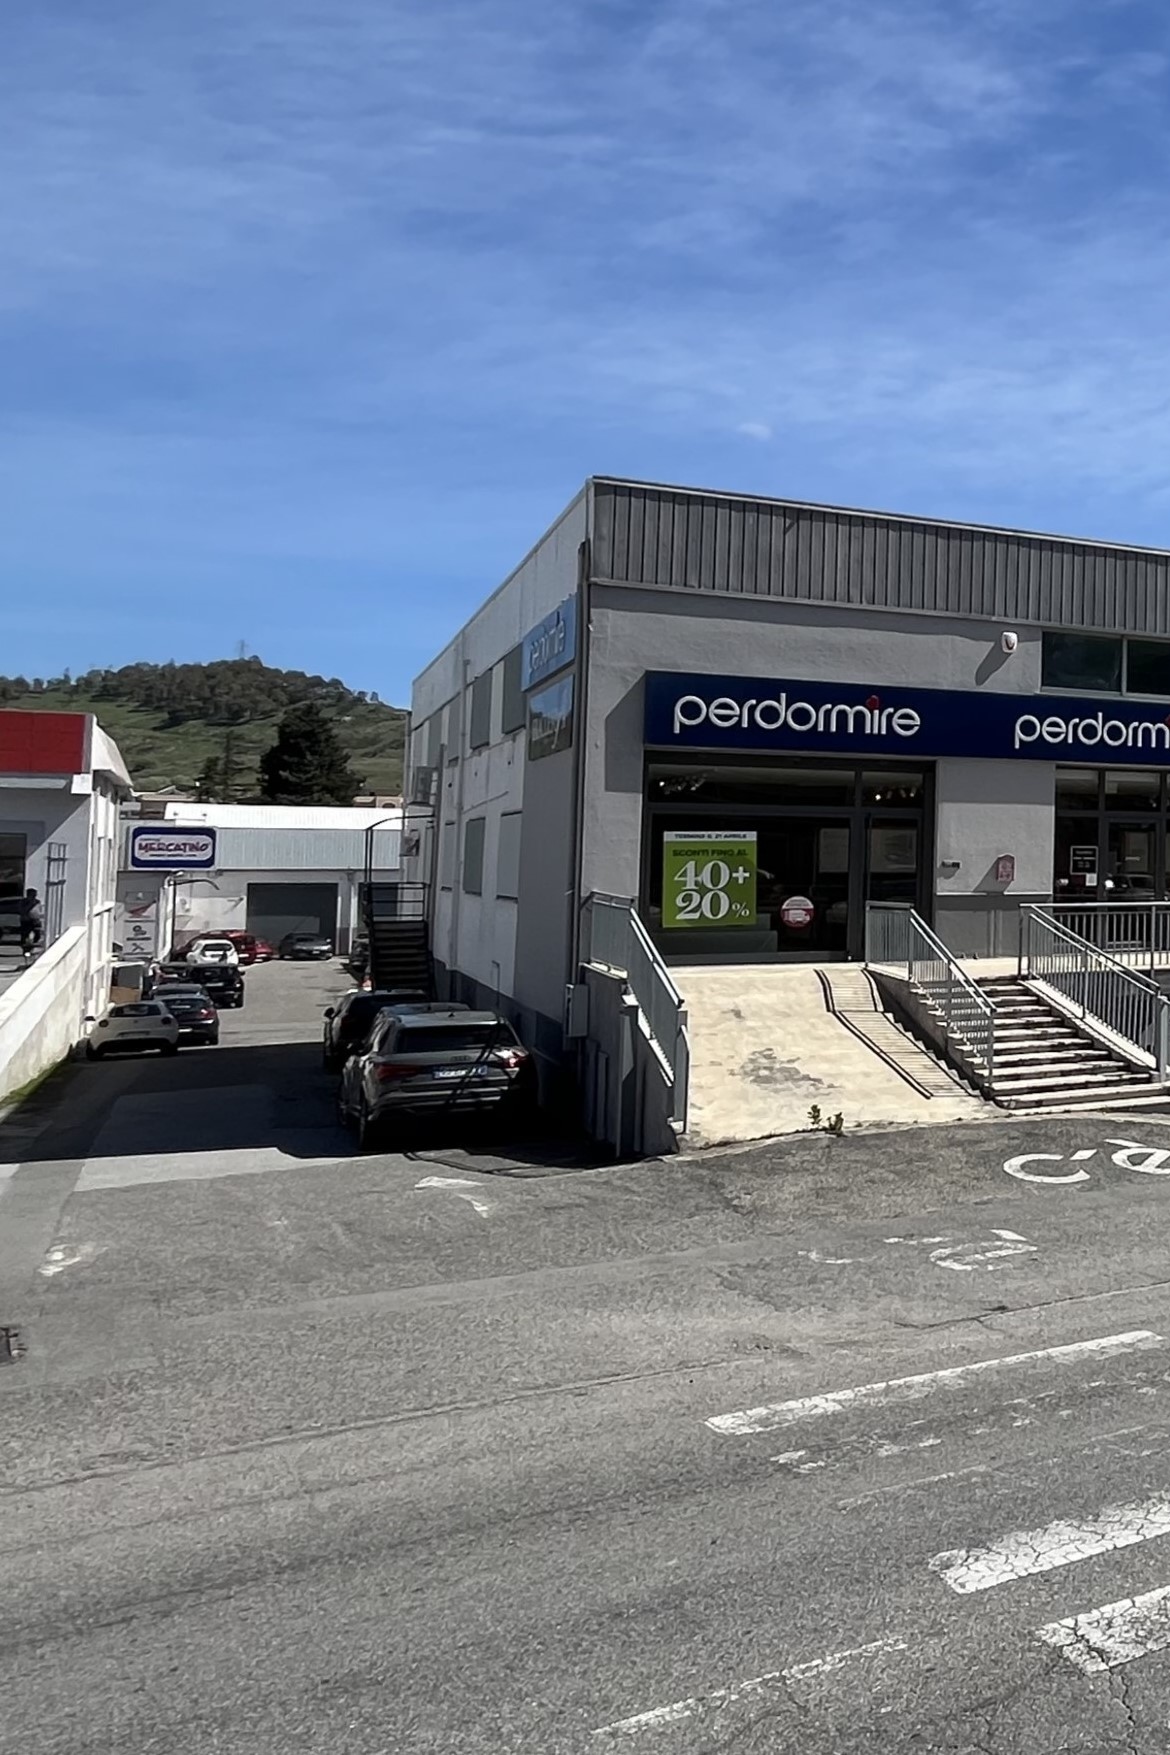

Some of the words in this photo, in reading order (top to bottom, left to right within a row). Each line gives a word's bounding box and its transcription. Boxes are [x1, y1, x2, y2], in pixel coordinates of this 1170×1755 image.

[672, 692, 922, 738] perdormire
[138, 841, 210, 853] MERCATINO
[672, 848, 709, 857] SCONTI
[710, 848, 734, 857] FINO
